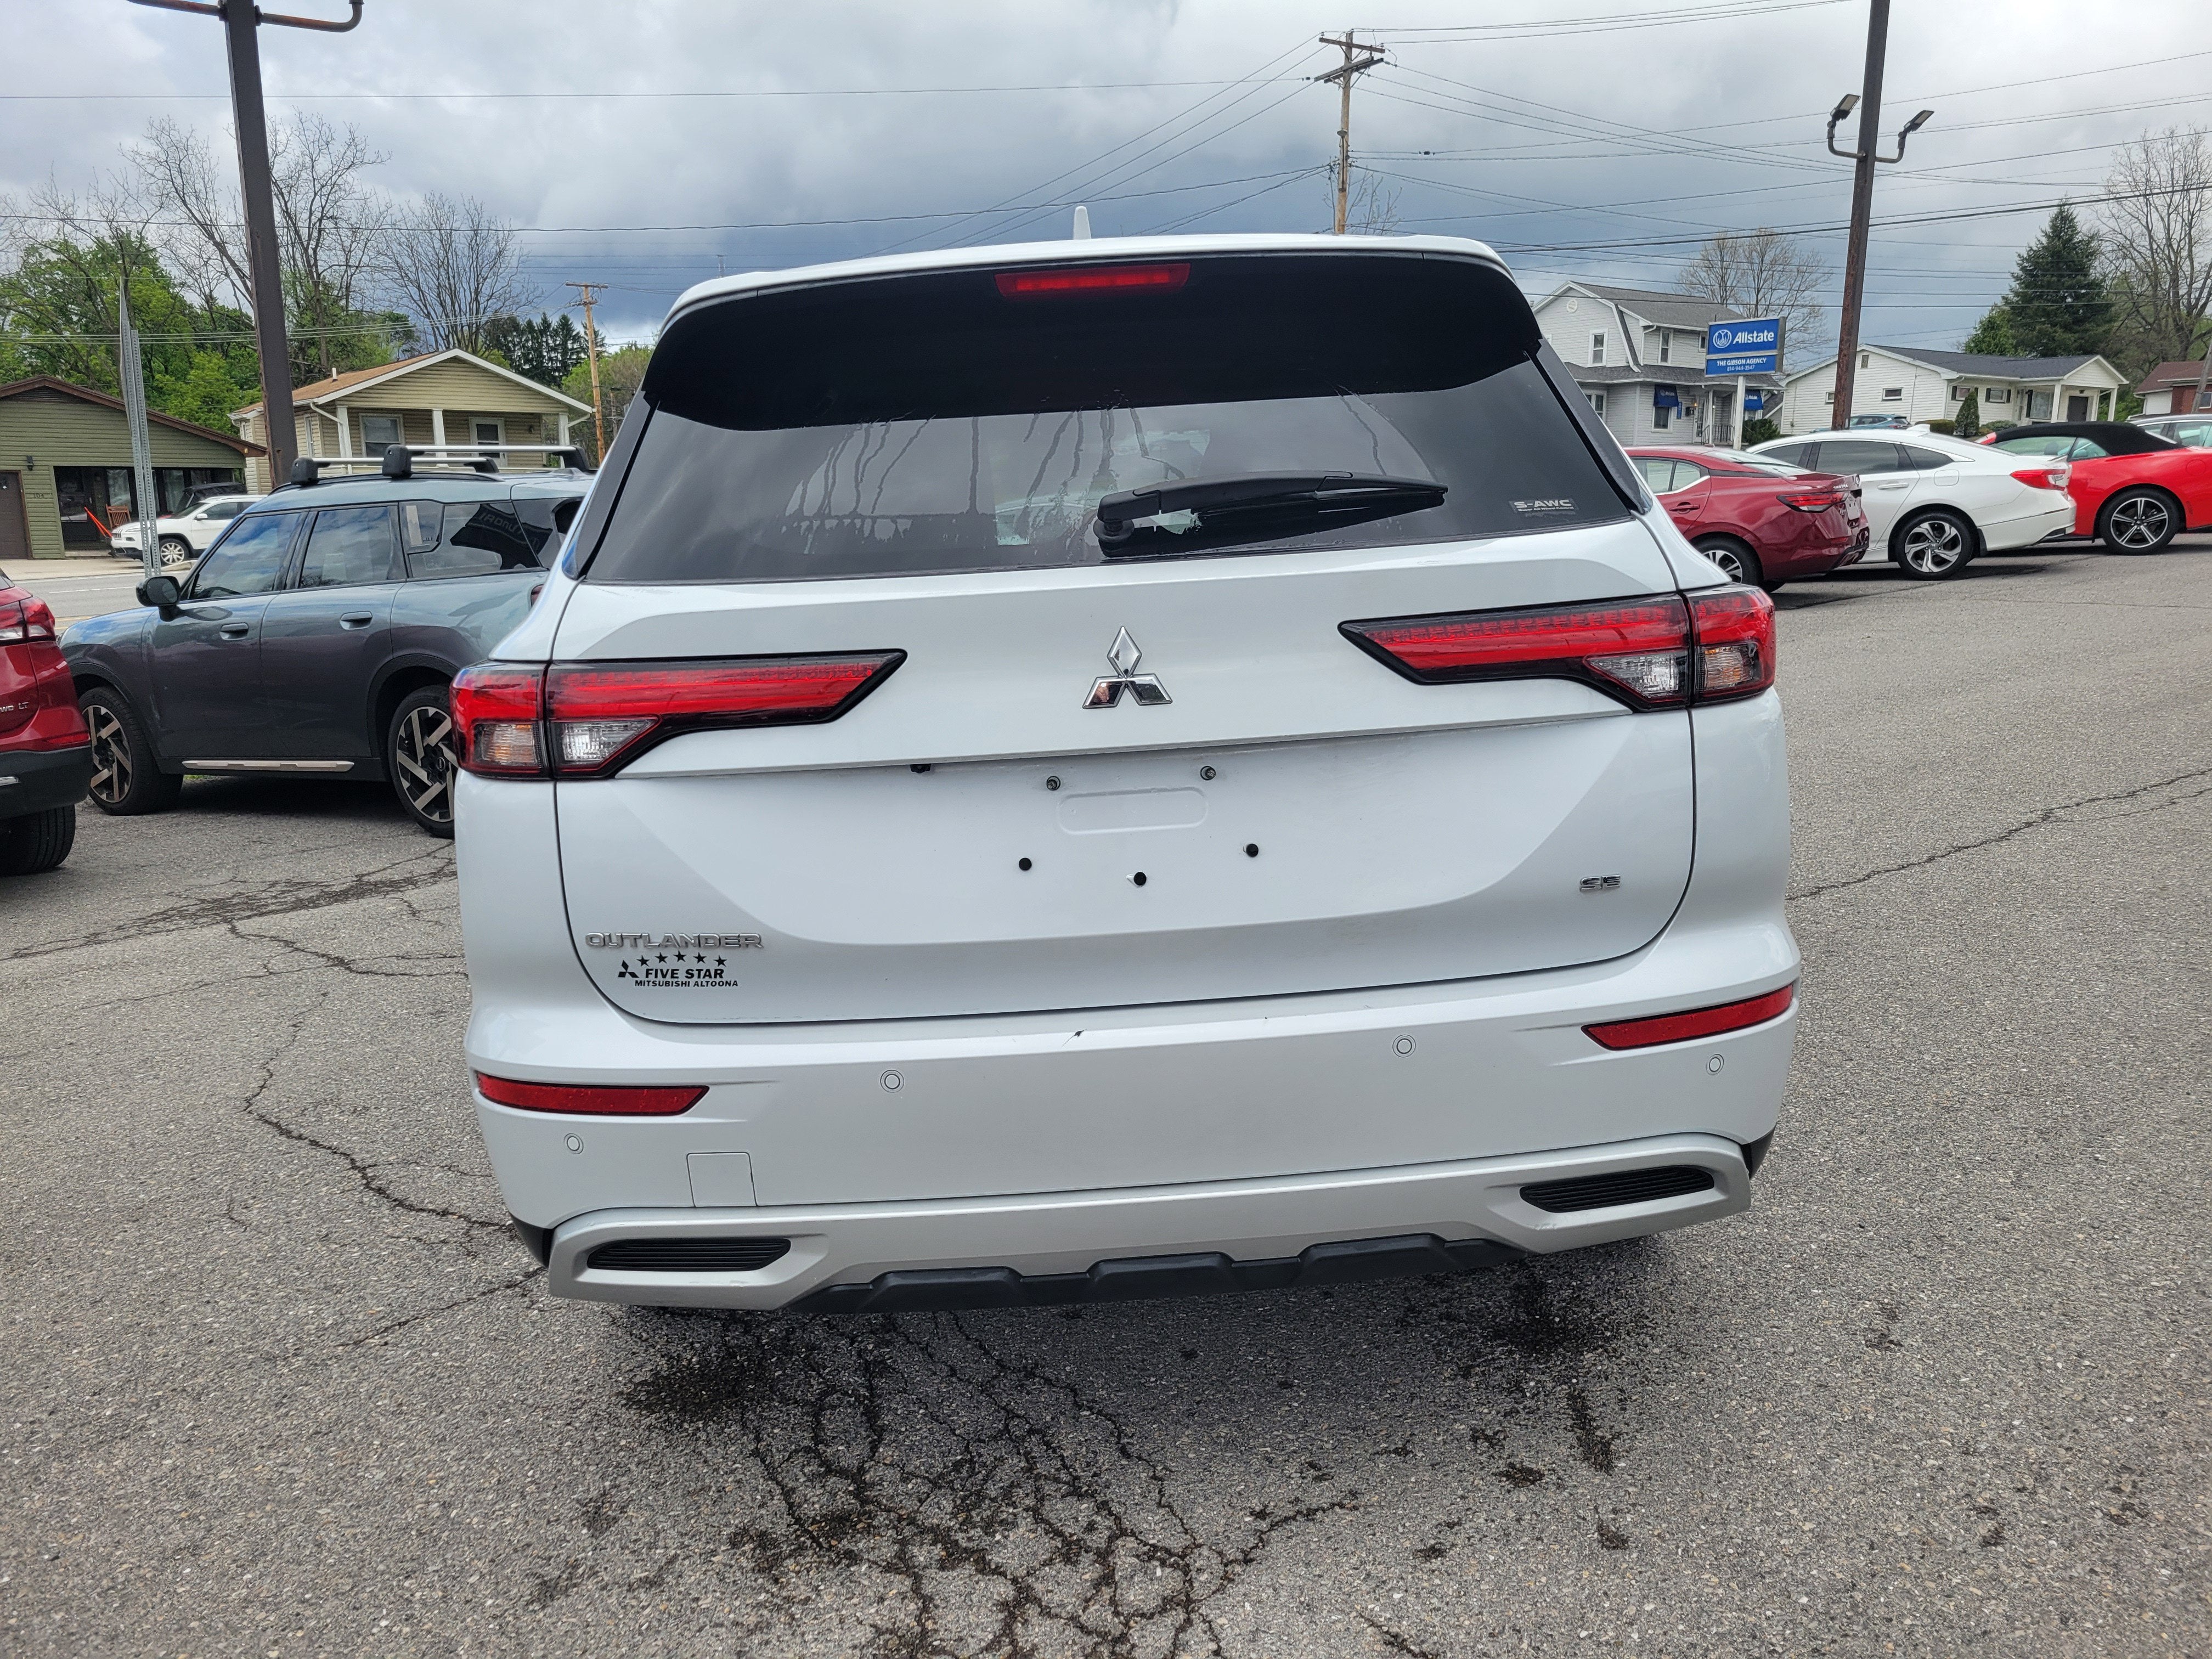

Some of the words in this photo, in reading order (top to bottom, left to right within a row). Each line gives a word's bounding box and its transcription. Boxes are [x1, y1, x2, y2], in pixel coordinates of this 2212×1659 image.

[1733, 330, 1774, 345] Allstate
[1514, 500, 1572, 508] S-AWC
[1580, 874, 1621, 891] SE
[585, 932, 764, 948] OUTLANDER
[645, 968, 680, 979] FIVE
[685, 968, 724, 979] STAR
